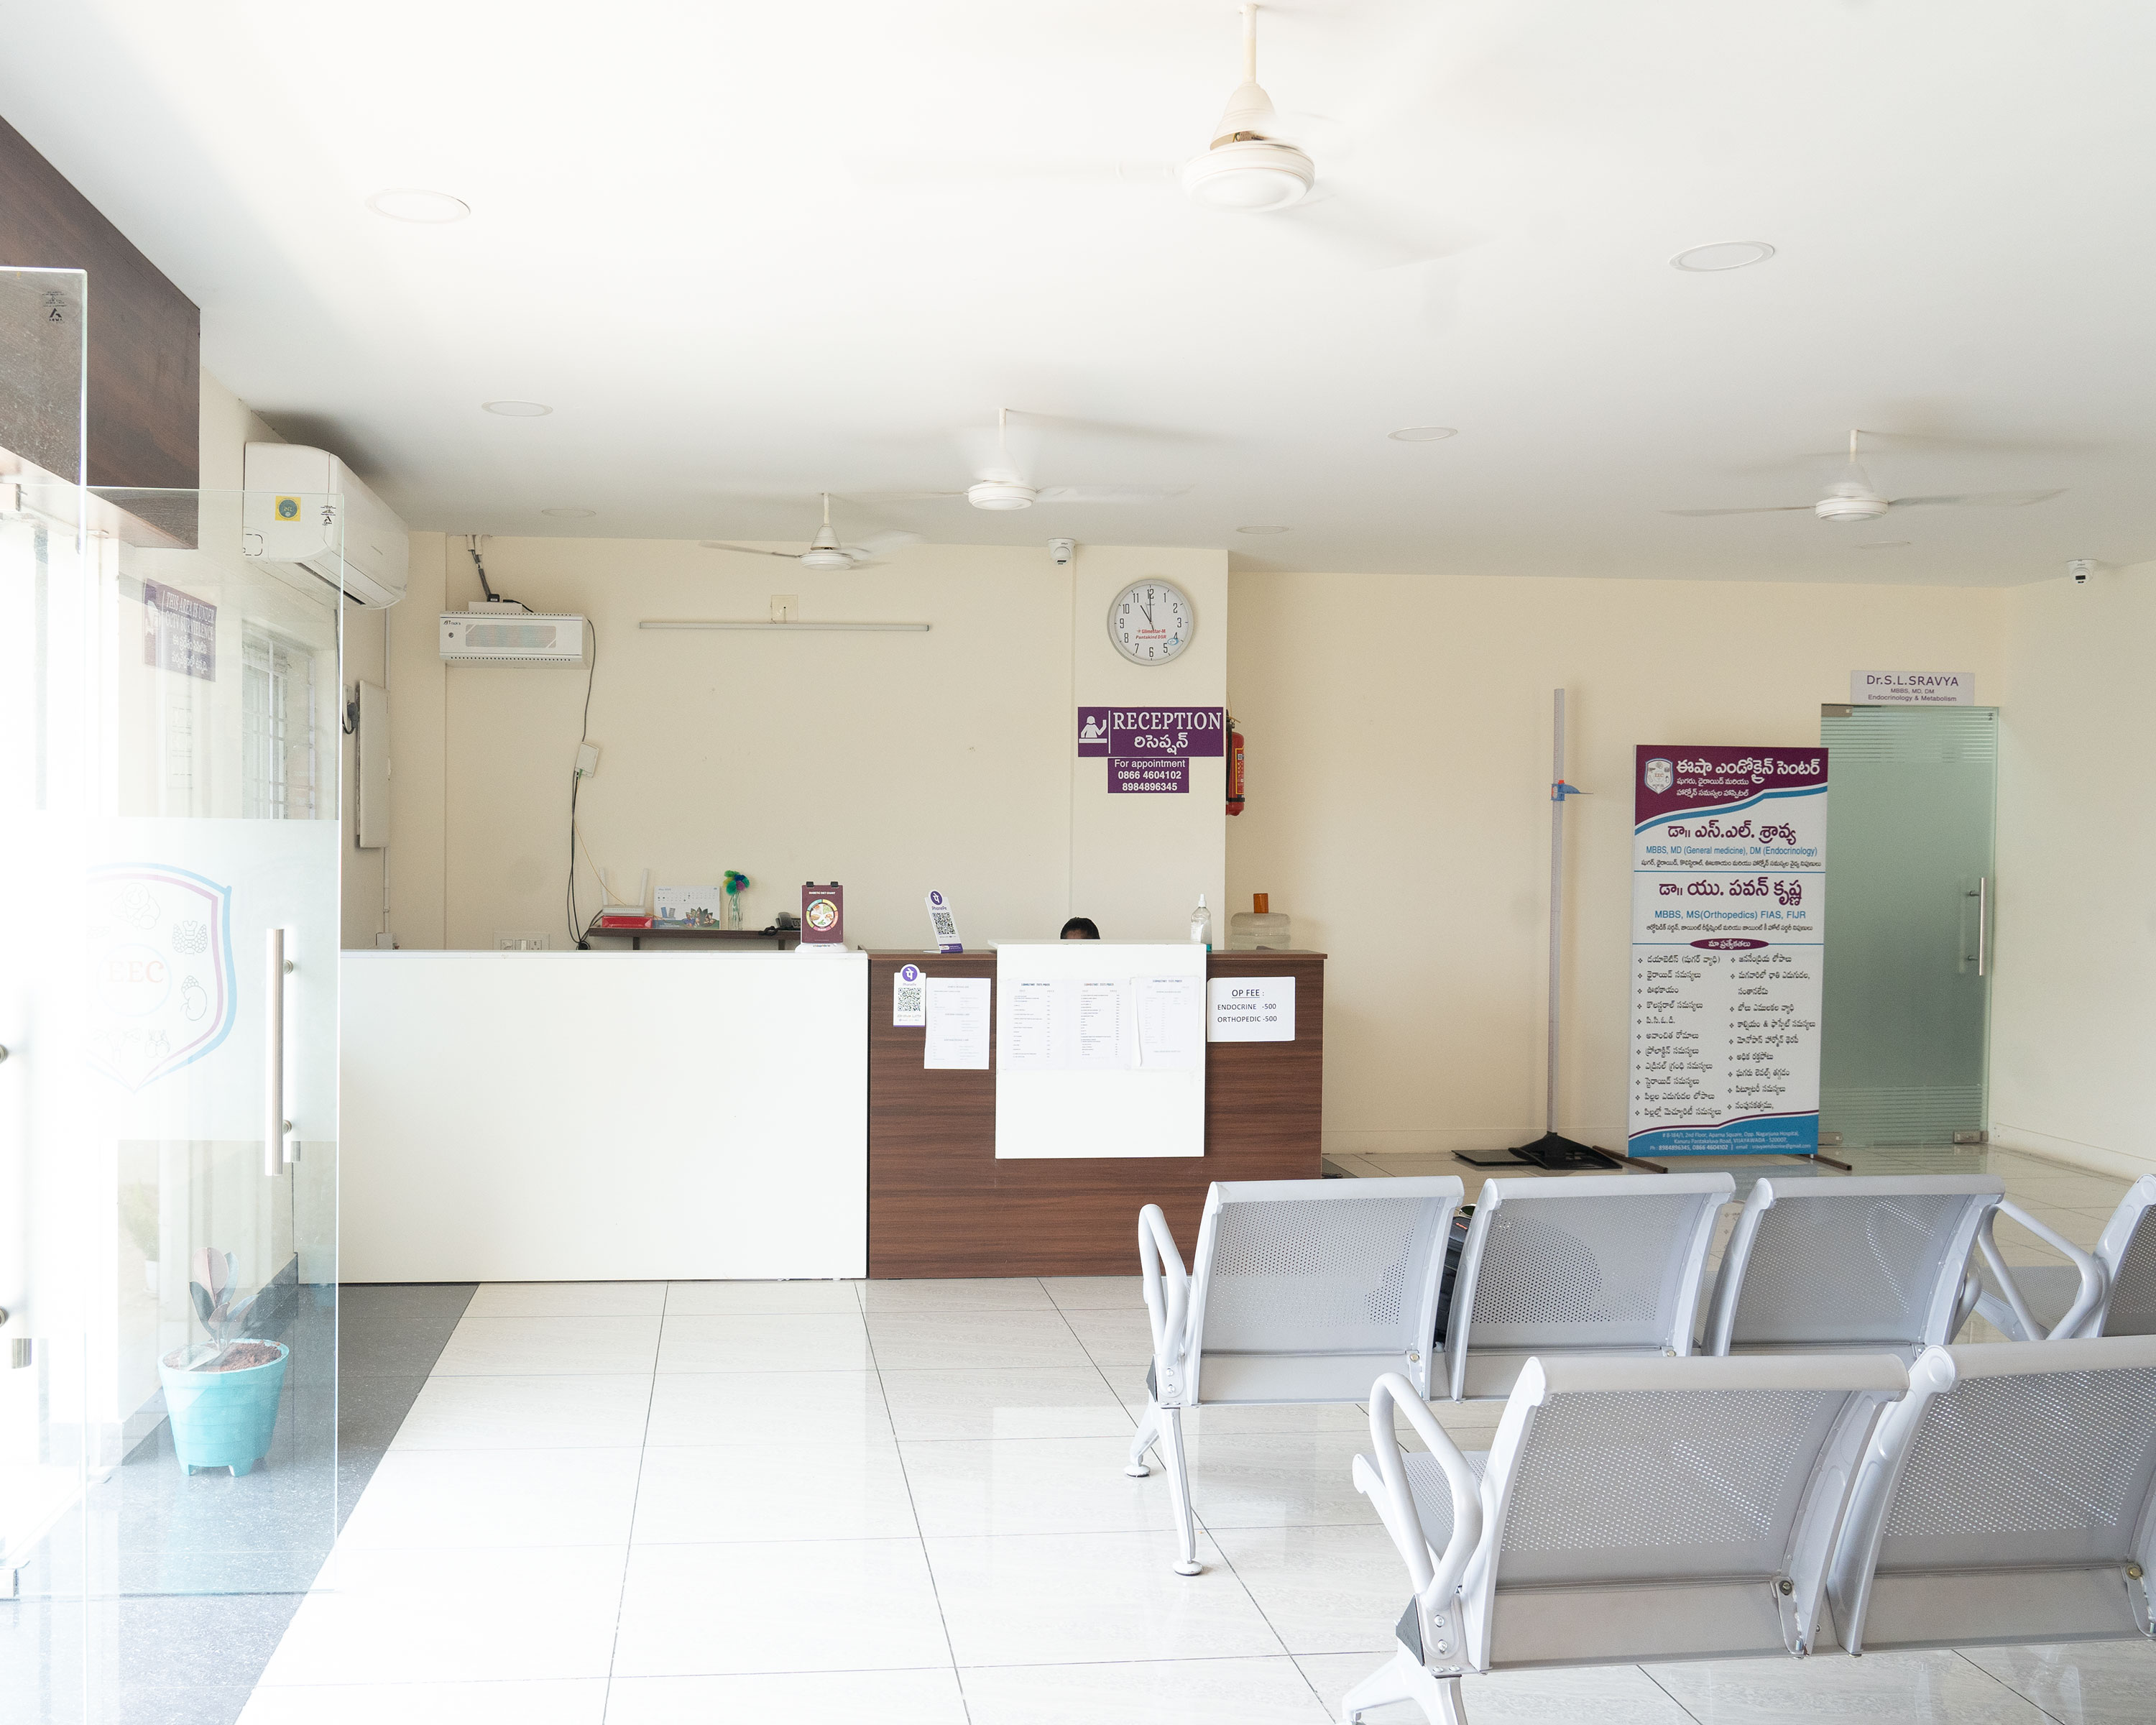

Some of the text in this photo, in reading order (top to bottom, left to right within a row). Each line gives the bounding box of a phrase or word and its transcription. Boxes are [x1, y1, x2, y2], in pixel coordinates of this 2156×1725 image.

[1133, 593, 1139, 603] 11
[1147, 589, 1154, 599] 12
[1164, 593, 1166, 603] 1
[167, 592, 215, 624] THIS AREA IS UNDER
[1123, 604, 1130, 614] 10
[1173, 603, 1178, 613] 2
[165, 611, 180, 629] CCTV
[1120, 618, 1125, 628] 9
[1177, 617, 1181, 628] 3
[1124, 632, 1128, 643] 8
[1135, 643, 1140, 654] 7
[1149, 647, 1154, 657] 6
[1163, 643, 1168, 653] 5
[1866, 674, 1959, 686] Dr.S.L.SRAVYA
[1113, 712, 1222, 730] RECEPTION
[1134, 732, 1189, 755] రిసెప్షన్
[1114, 759, 1186, 769] For appointment
[1118, 770, 1181, 779] 0866 4604102
[1676, 757, 1820, 784] ఈషా ఎండోక్రైన్ సెంటర్
[1646, 845, 1669, 855] MBBS,
[1684, 846, 1713, 855] (General
[1713, 846, 1749, 856] medicine),
[1763, 847, 1818, 857] (Endocrinology)
[1729, 877, 1769, 896] పవన్
[1774, 880, 1802, 906] కృష్ణ
[1654, 910, 1684, 920] MBBS,
[1686, 910, 1758, 920] MS(Orthopedics)
[1761, 911, 1784, 920] FIAS,
